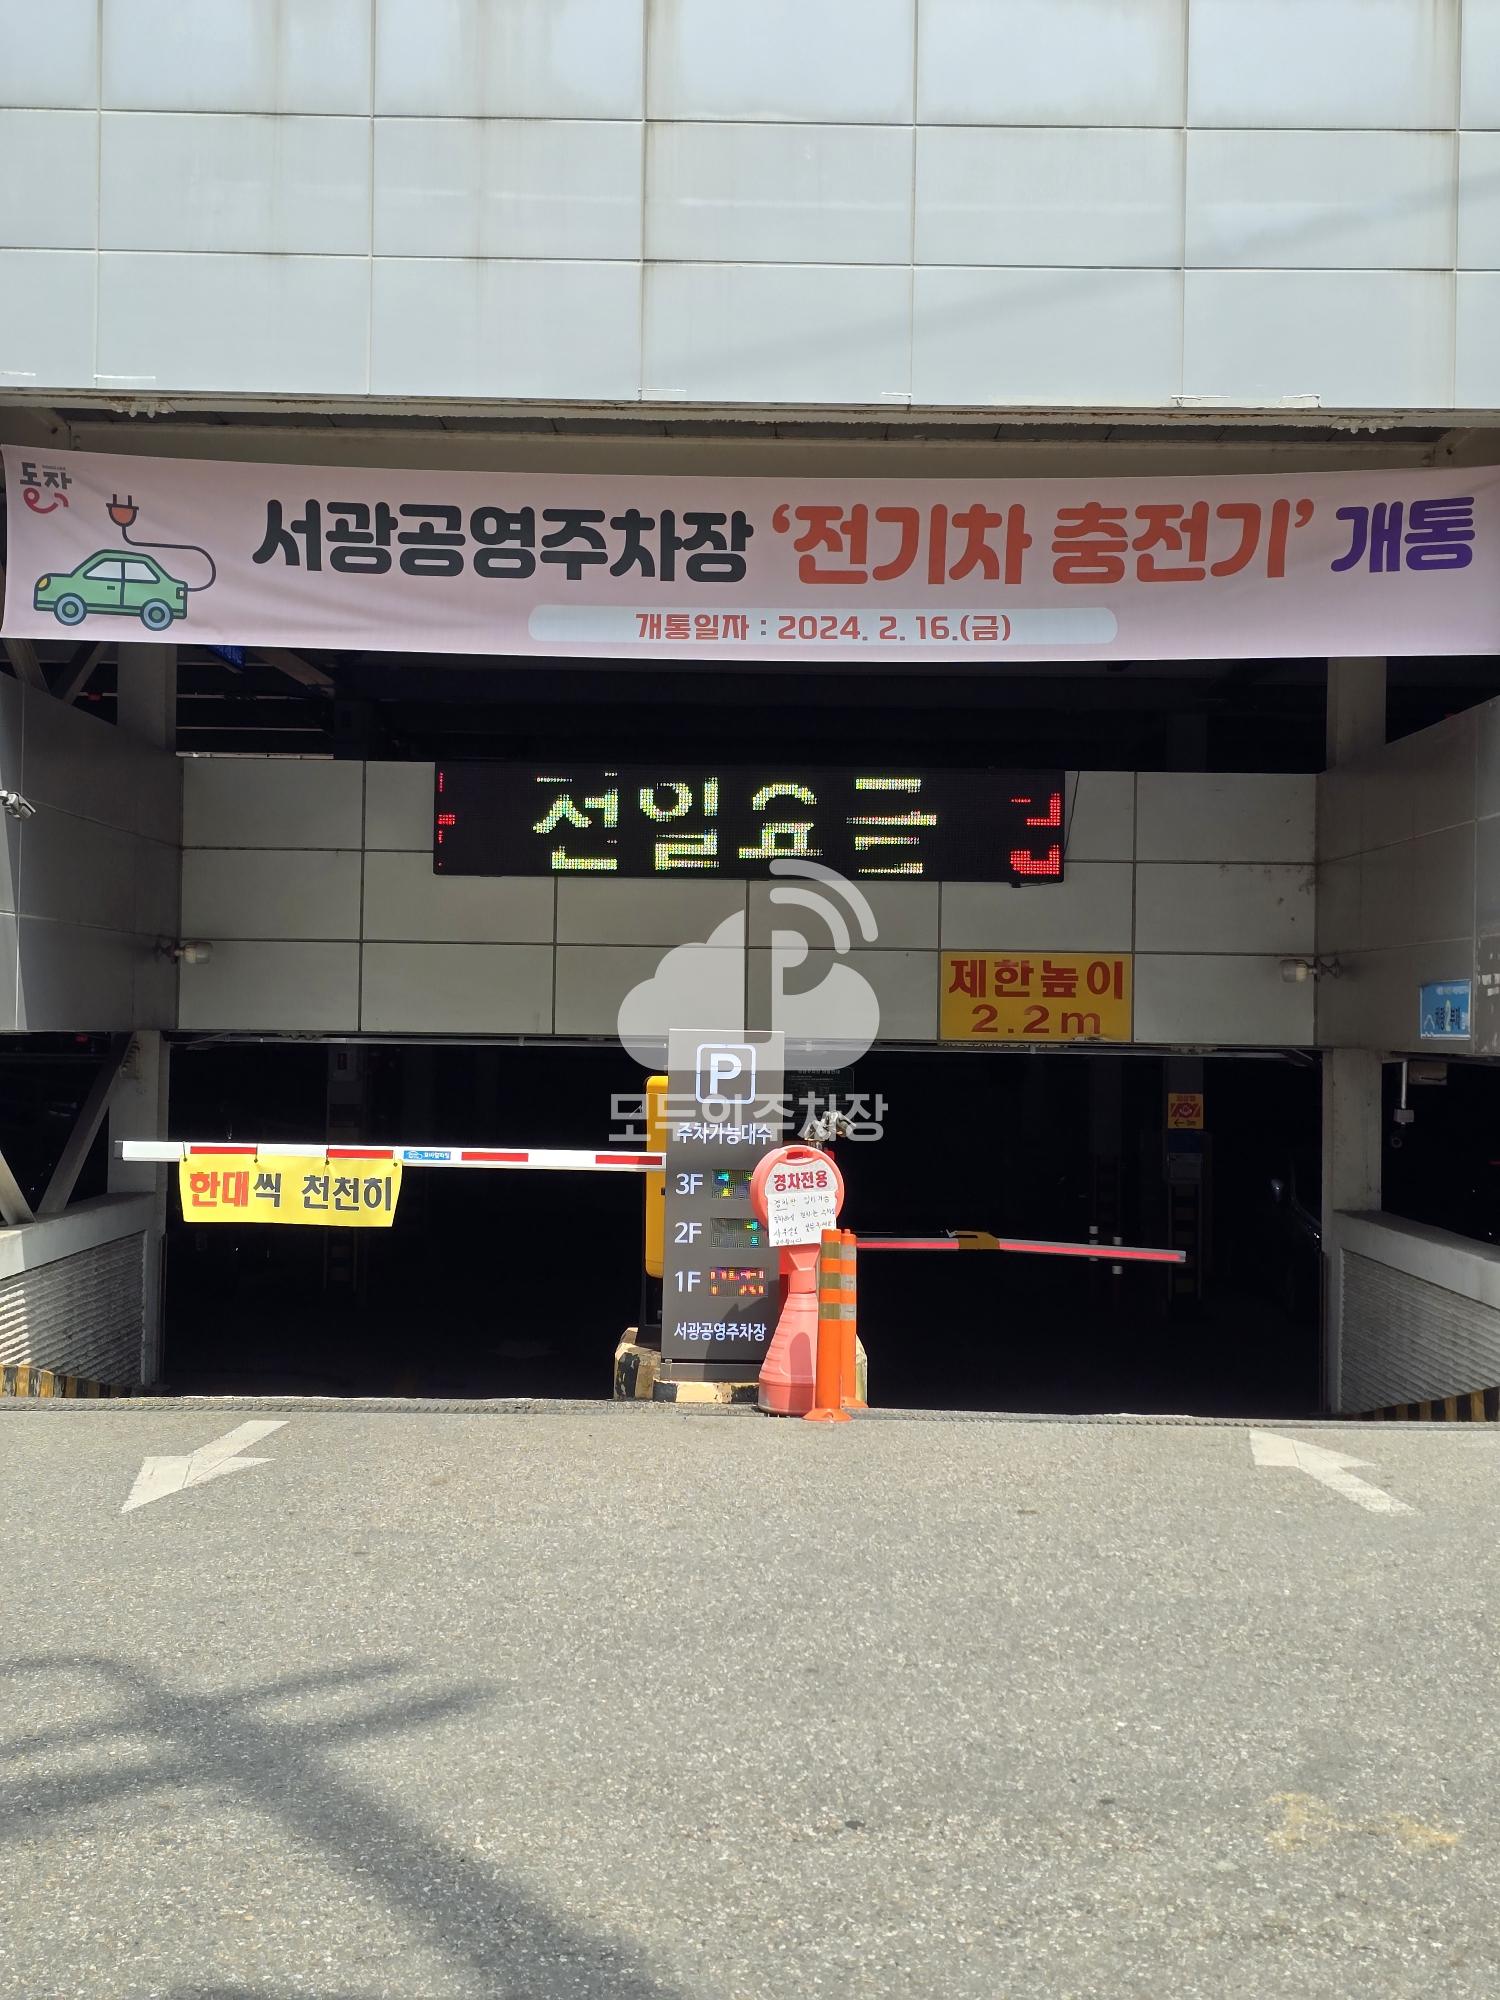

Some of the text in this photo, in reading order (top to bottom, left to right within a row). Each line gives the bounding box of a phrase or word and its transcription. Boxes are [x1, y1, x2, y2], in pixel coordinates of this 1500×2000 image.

[252, 495, 1474, 585] 서광공영주차장 ‘전기차 충전기’ 개통
[635, 613, 749, 641] 개통일자
[777, 615, 869, 641] 2024.
[878, 615, 907, 641] 2.
[915, 614, 1011, 642] 16.(금)
[948, 959, 1124, 1000] 제한높이
[970, 1004, 1102, 1035] 2.2m
[677, 1122, 773, 1145] 주차가능대수
[188, 1171, 392, 1212] 한대씩 천천히
[675, 1174, 703, 1194] 3F
[774, 1170, 828, 1191] 경차전용
[675, 1222, 703, 1243] 2F
[675, 1271, 701, 1292] 1F
[674, 1321, 767, 1342] 서광공영주차장
